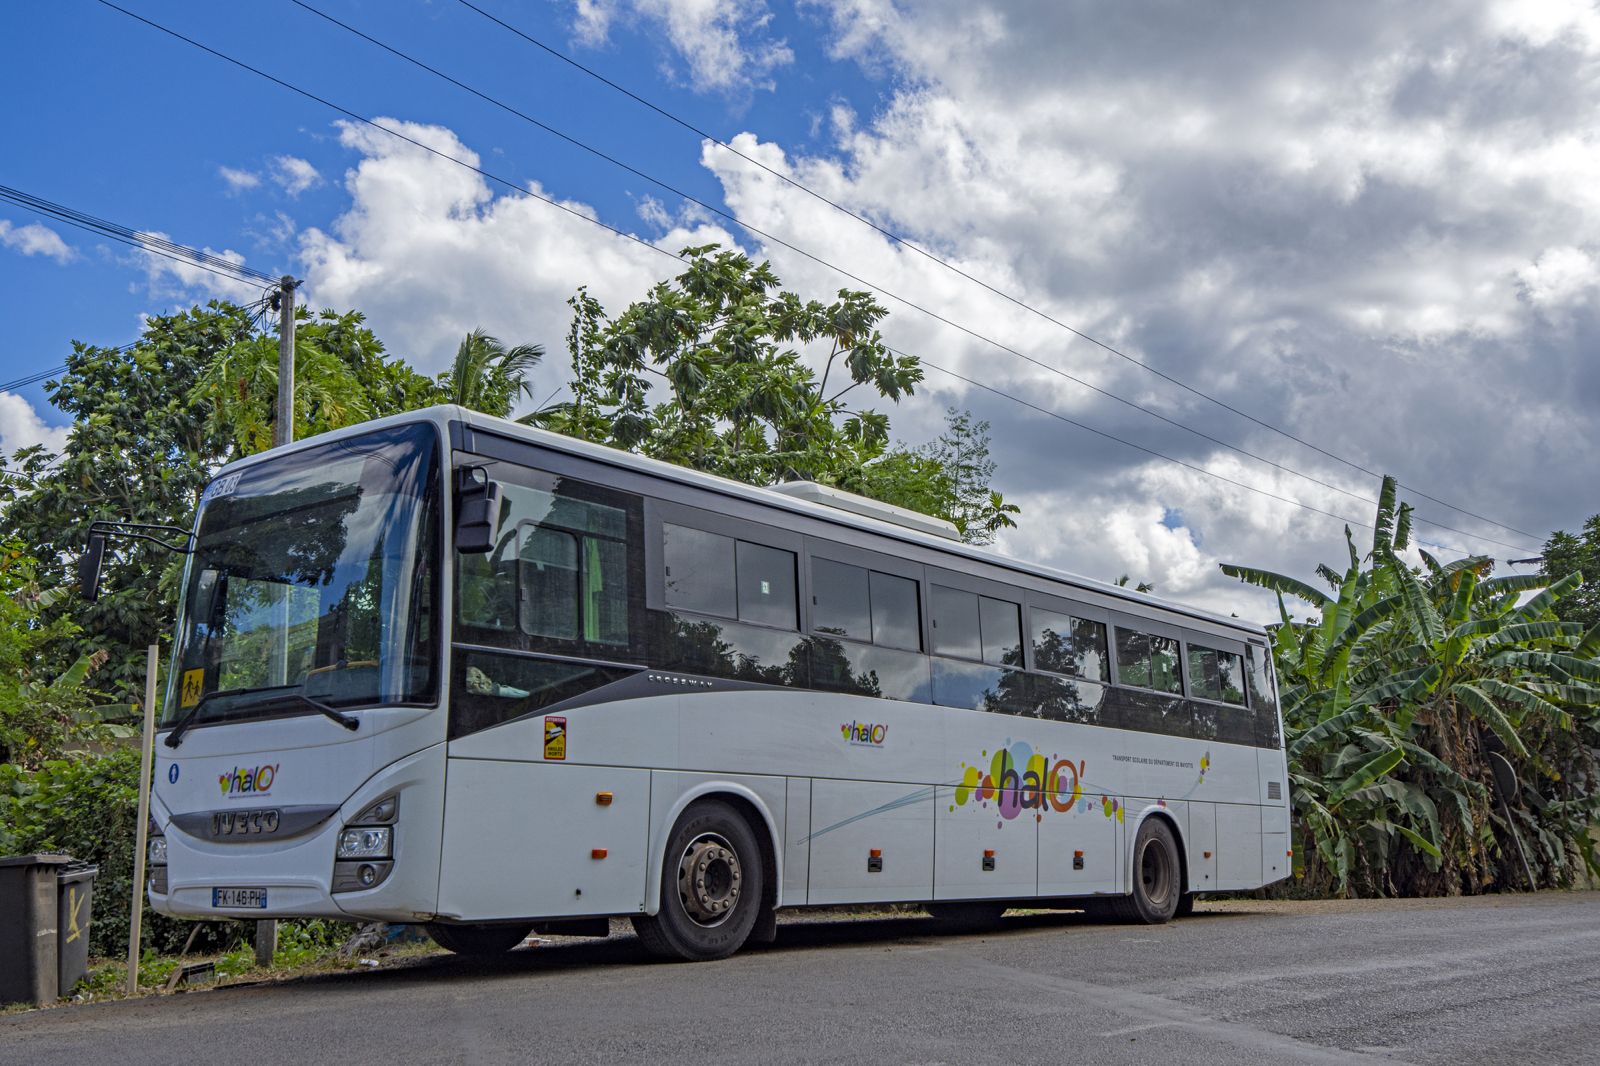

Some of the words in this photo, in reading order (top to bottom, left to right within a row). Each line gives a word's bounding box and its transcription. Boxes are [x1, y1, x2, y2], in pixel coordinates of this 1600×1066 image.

[648, 674, 713, 688] CROSSWAY
[1112, 754, 1132, 762] TRANSPORT
[212, 809, 280, 835] IVECO
